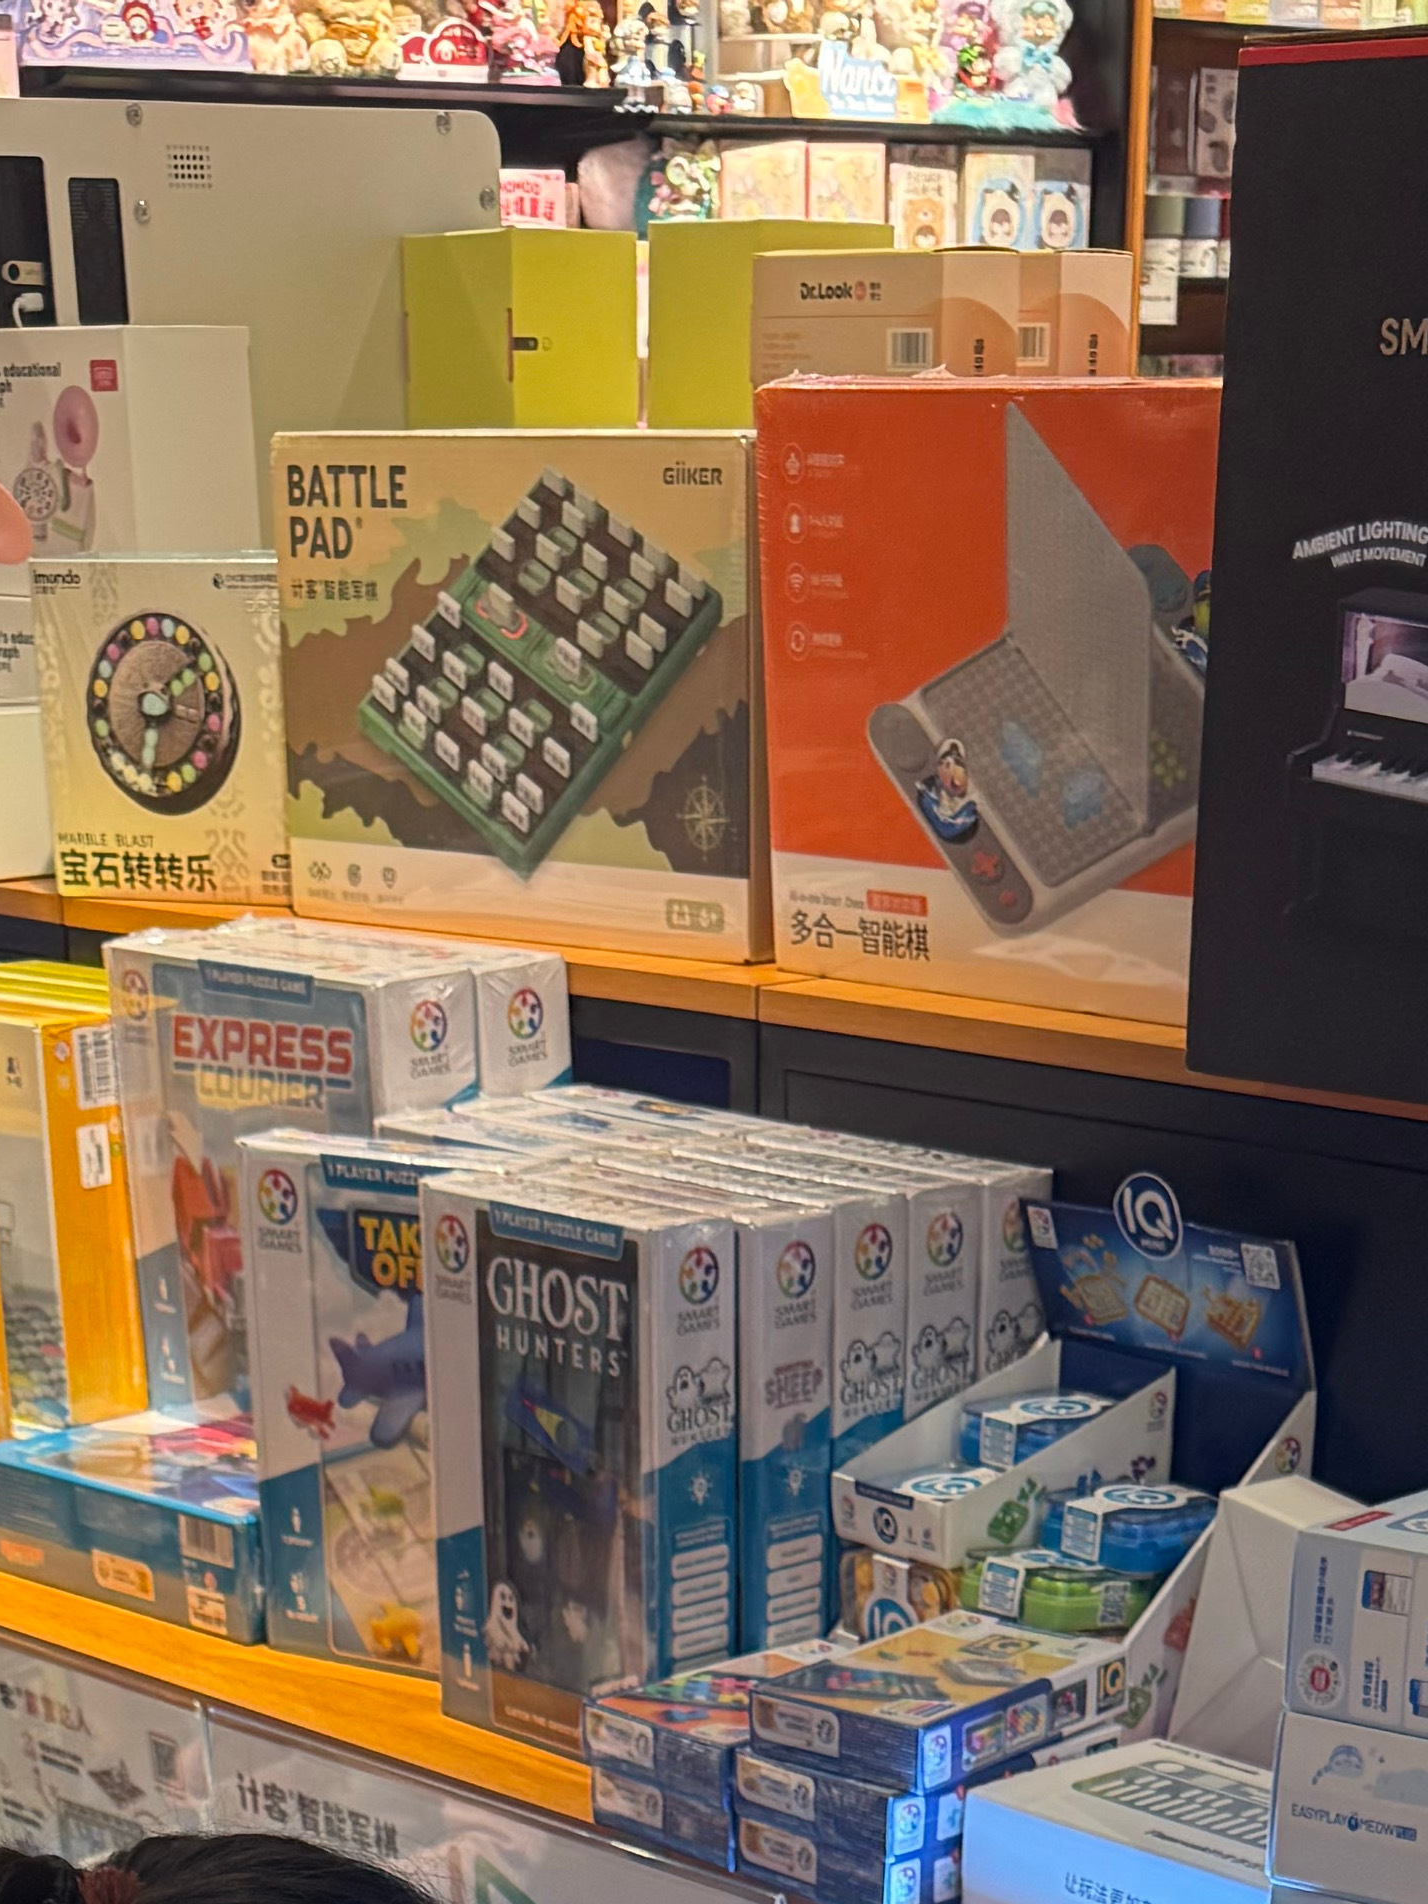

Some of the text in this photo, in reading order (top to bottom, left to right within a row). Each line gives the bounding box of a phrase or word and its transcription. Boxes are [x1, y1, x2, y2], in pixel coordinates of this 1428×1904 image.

[286, 464, 408, 509] BATTLE
[289, 516, 355, 560] PAD
[1292, 524, 1356, 560] AMBIENT
[1330, 546, 1427, 568] WAVE MOVEMENT
[58, 832, 155, 849] MARBLE BLAST
[58, 849, 218, 892] 宝石转转乐
[790, 910, 932, 962] 多合一智能棋
[173, 1014, 354, 1076] EXPRESS
[195, 1066, 325, 1110] COURIER
[1123, 1186, 1175, 1240] IQ
[486, 1256, 628, 1342] GHOST
[495, 1323, 621, 1378] HUNTERS
[840, 1375, 904, 1406] GHOST
[667, 1402, 734, 1434] GHOST
[1097, 1658, 1124, 1697] IQ
[1291, 1803, 1347, 1826] EASYPLAY
[1359, 1817, 1395, 1836] MEOW
